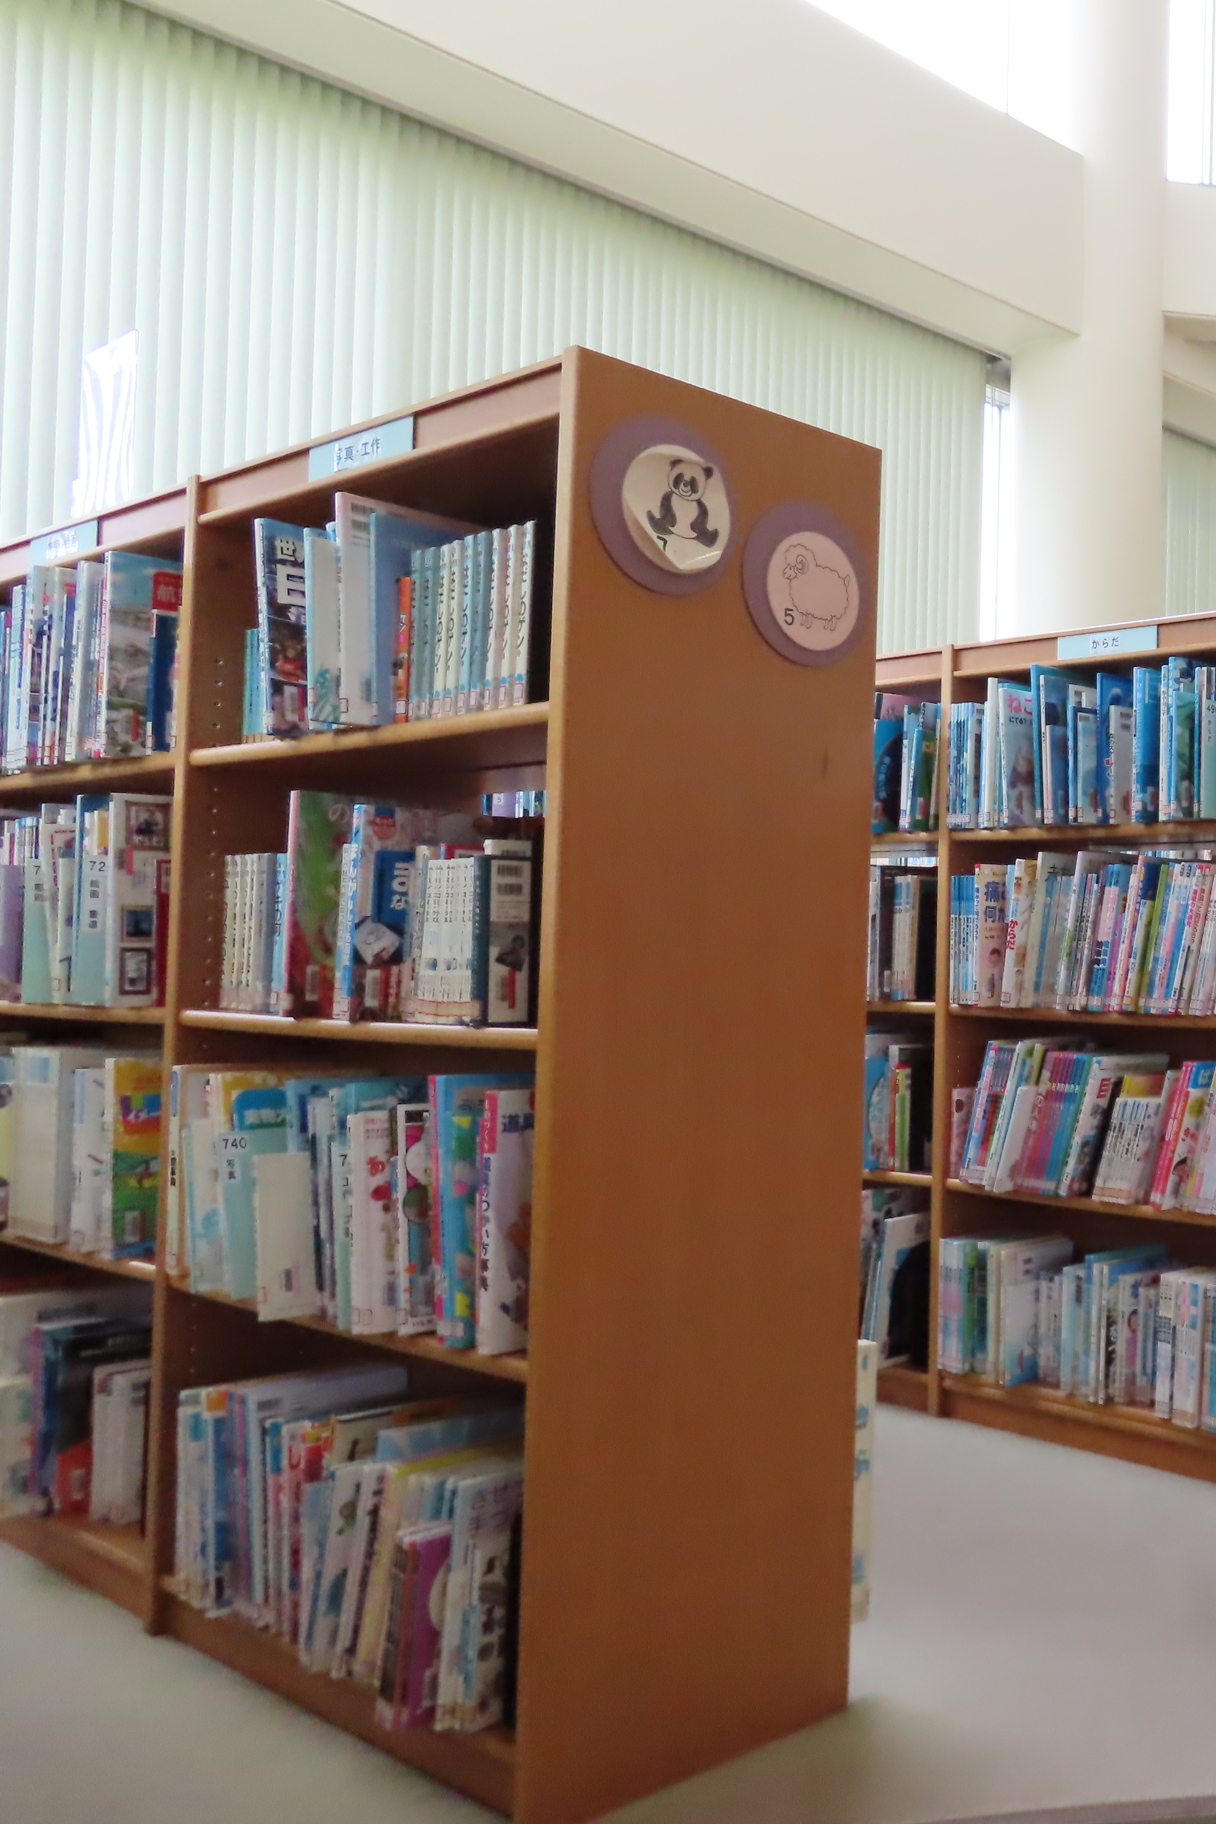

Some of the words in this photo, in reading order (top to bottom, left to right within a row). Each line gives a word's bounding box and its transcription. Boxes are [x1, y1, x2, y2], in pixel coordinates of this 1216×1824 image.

[783, 607, 795, 626] 5
[1091, 636, 1120, 649] からだ
[1006, 918, 1019, 951] からだ
[222, 1136, 248, 1150] 740
